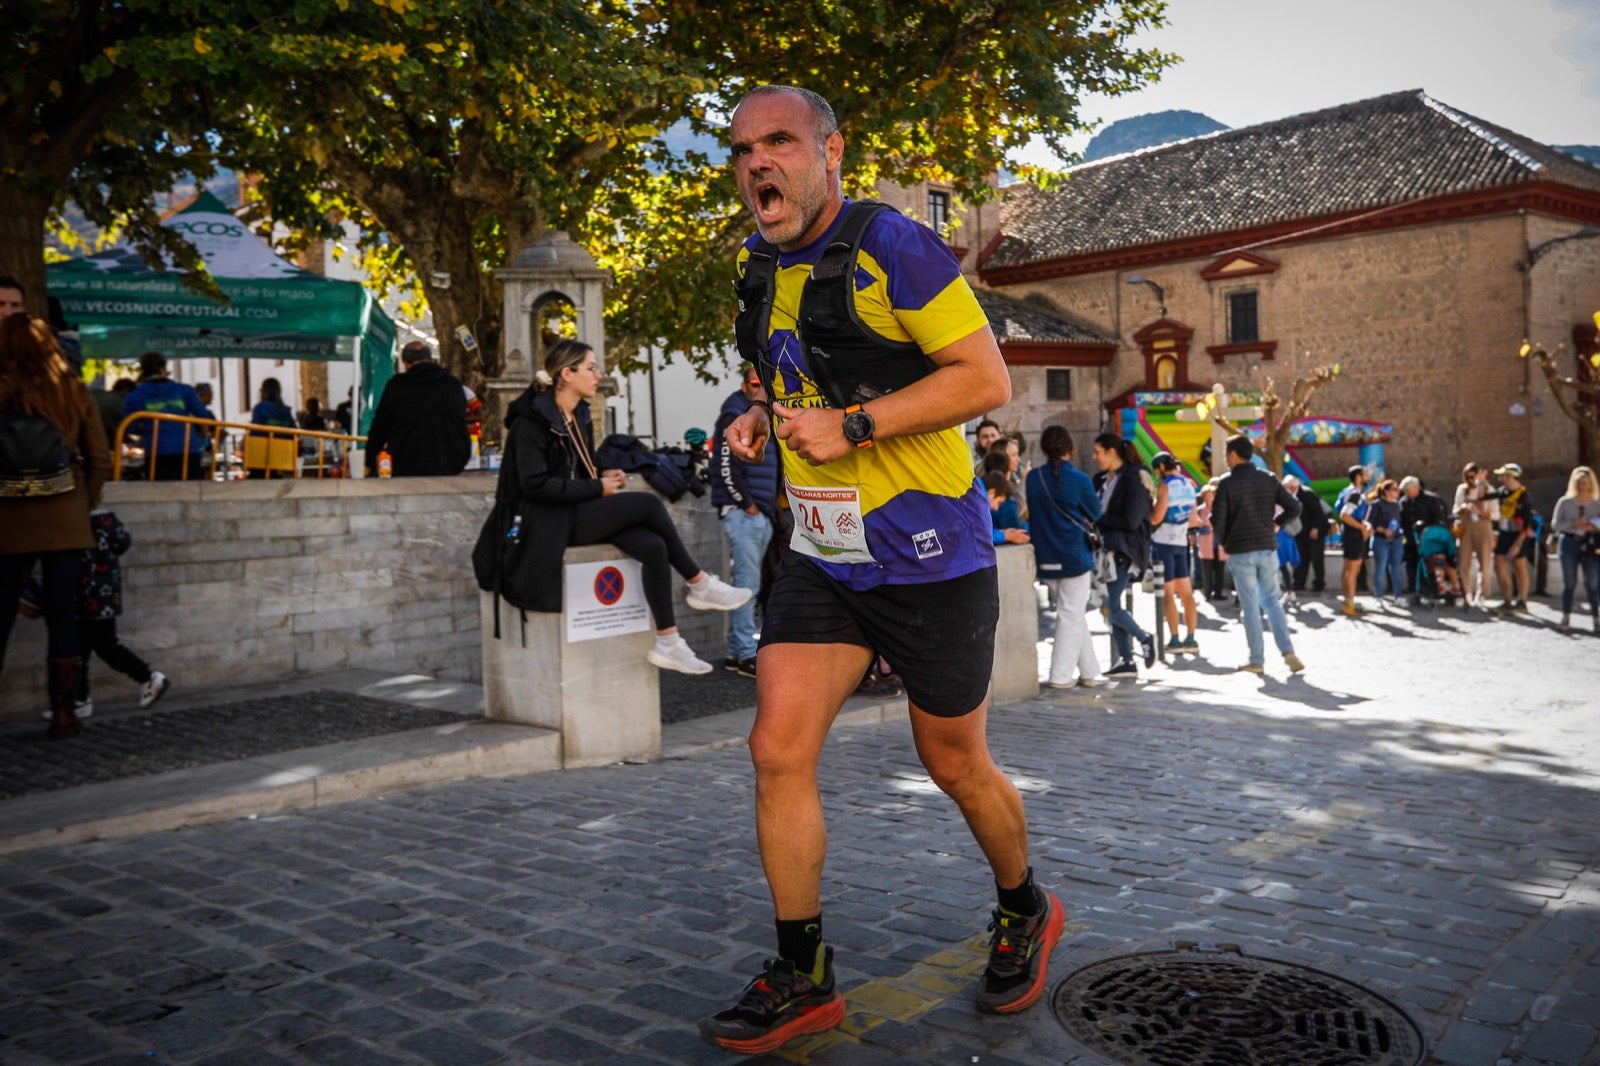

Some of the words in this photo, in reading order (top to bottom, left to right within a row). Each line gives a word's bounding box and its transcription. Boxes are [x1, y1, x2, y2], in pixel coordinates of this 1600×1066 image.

[106, 280, 176, 292] naturaleza
[243, 286, 260, 298] de
[262, 288, 276, 298] tu
[279, 289, 314, 300] mano
[800, 490, 822, 498] CARAS
[799, 503, 825, 535] 24
